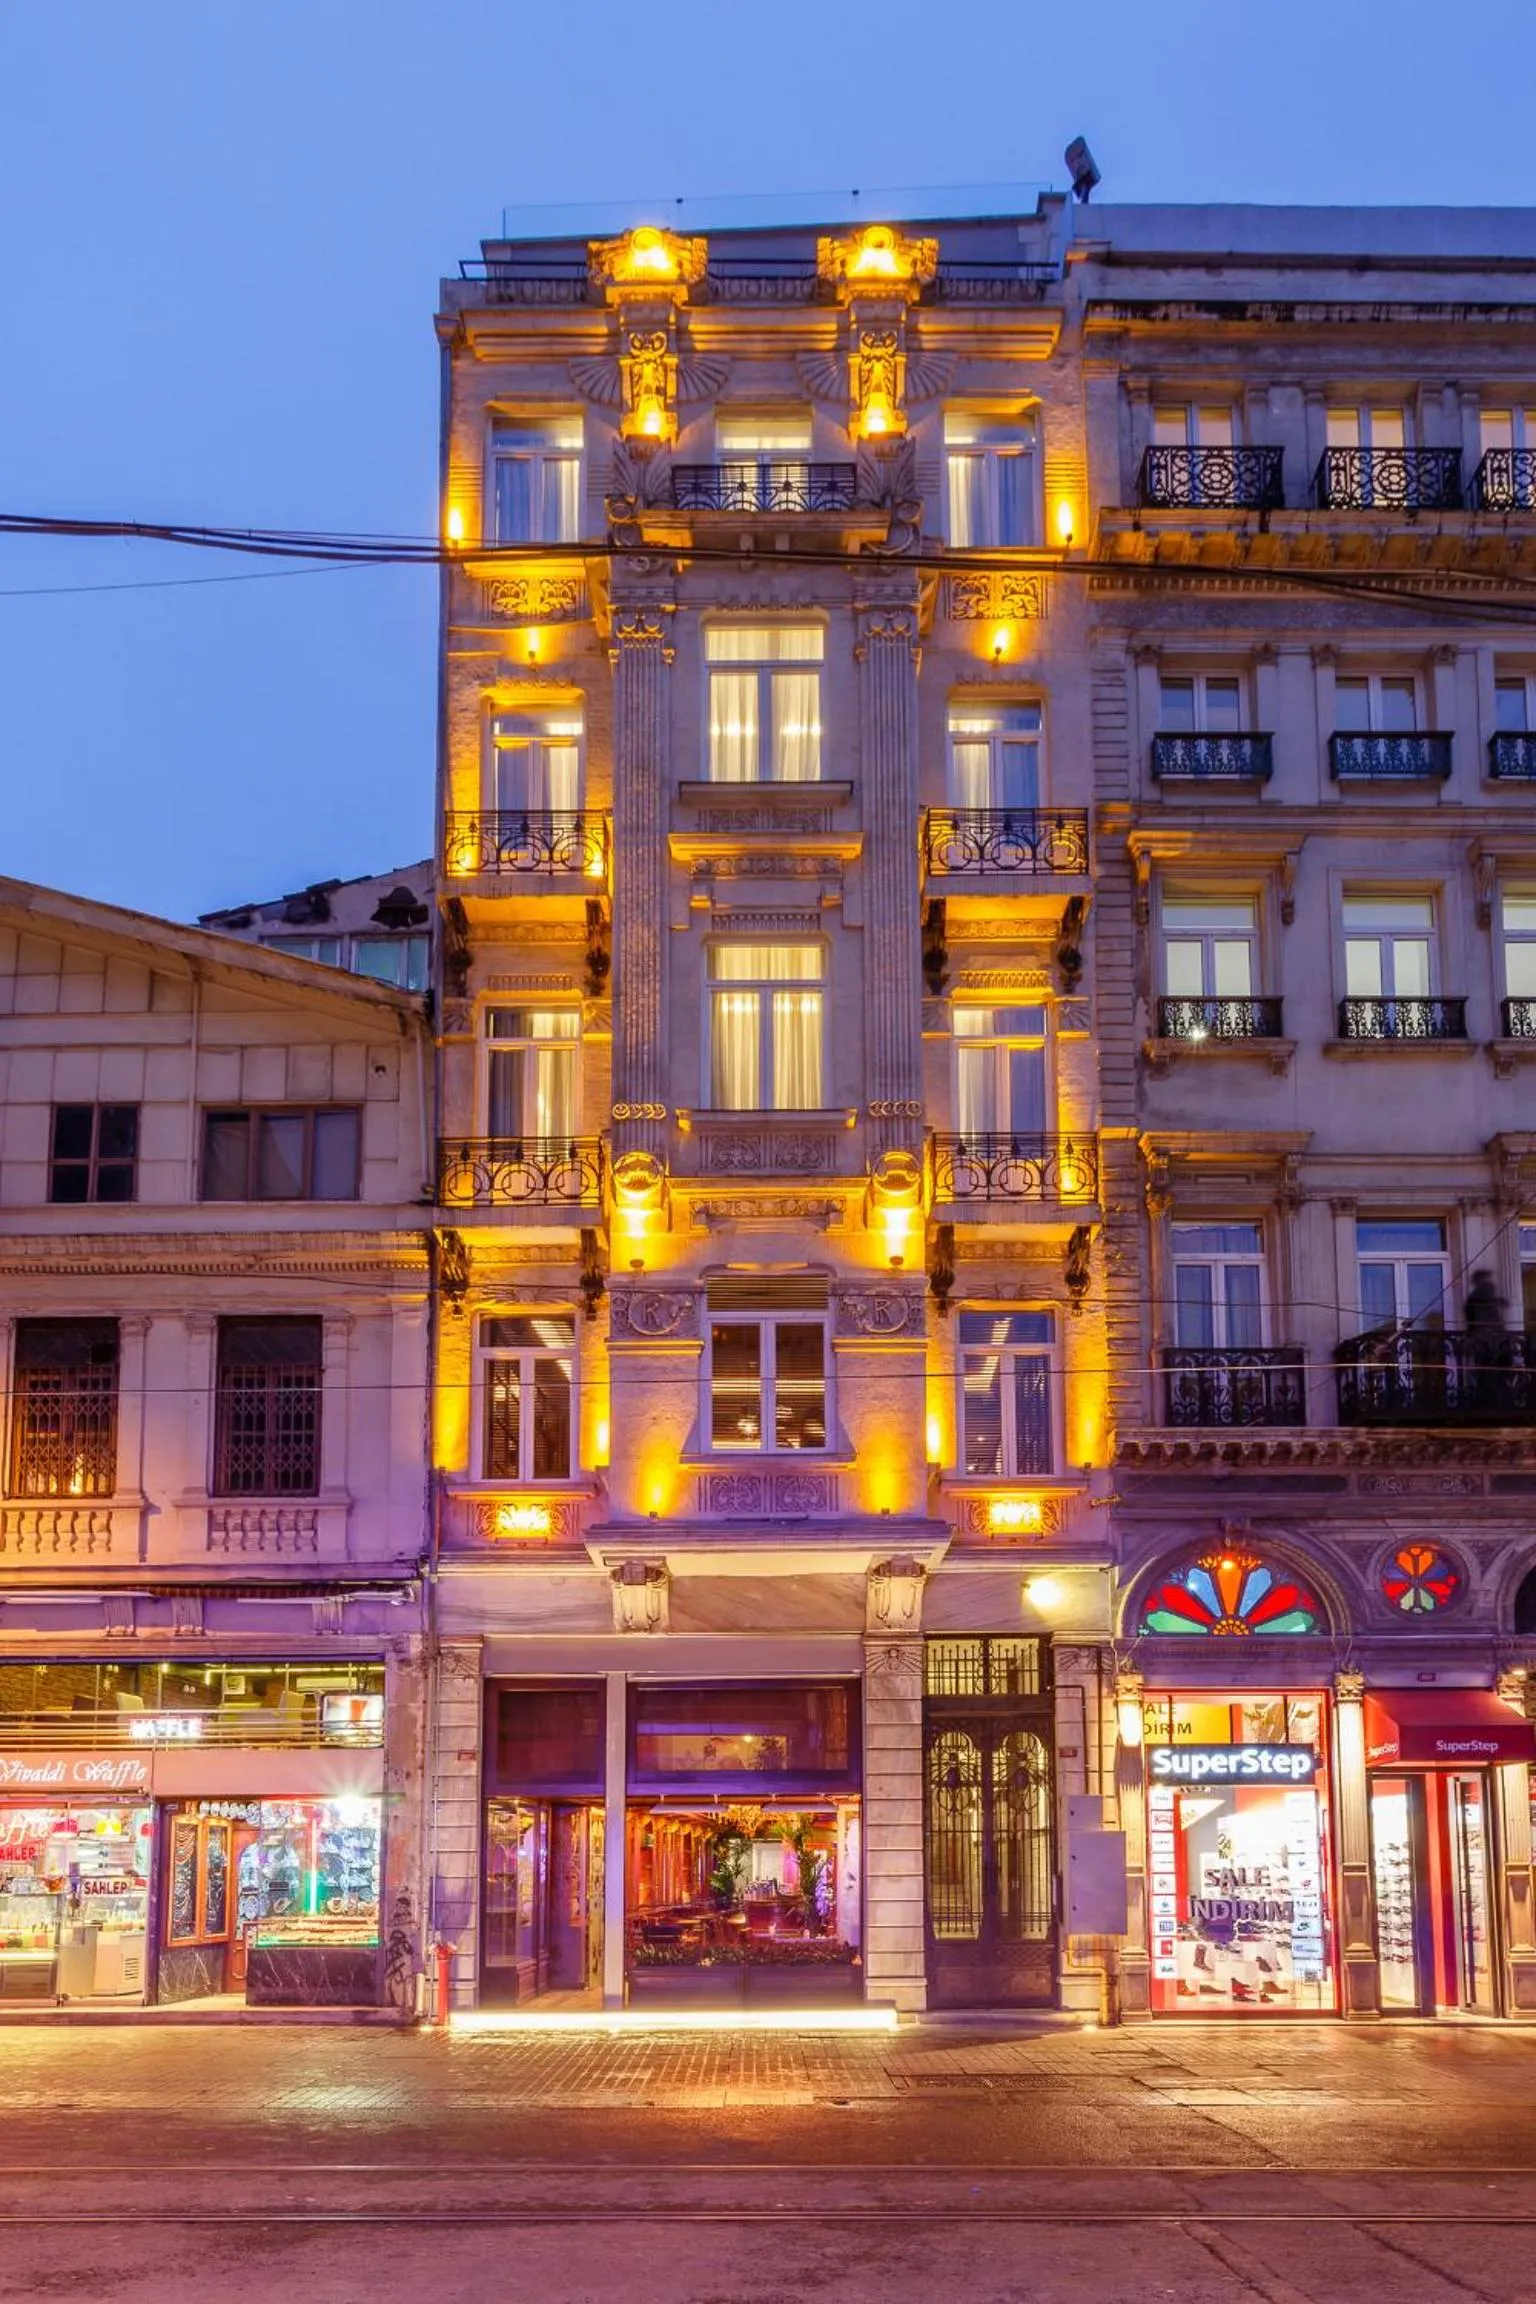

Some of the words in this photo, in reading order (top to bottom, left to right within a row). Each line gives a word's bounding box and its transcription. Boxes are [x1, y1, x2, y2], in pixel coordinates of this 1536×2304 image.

[1145, 1701, 1177, 1715] ALE
[1436, 1740, 1498, 1753] SuperStep
[1152, 1749, 1311, 1780] SuperStep
[1204, 1868, 1270, 1887] SALE
[84, 1881, 127, 1895] SAHLEP
